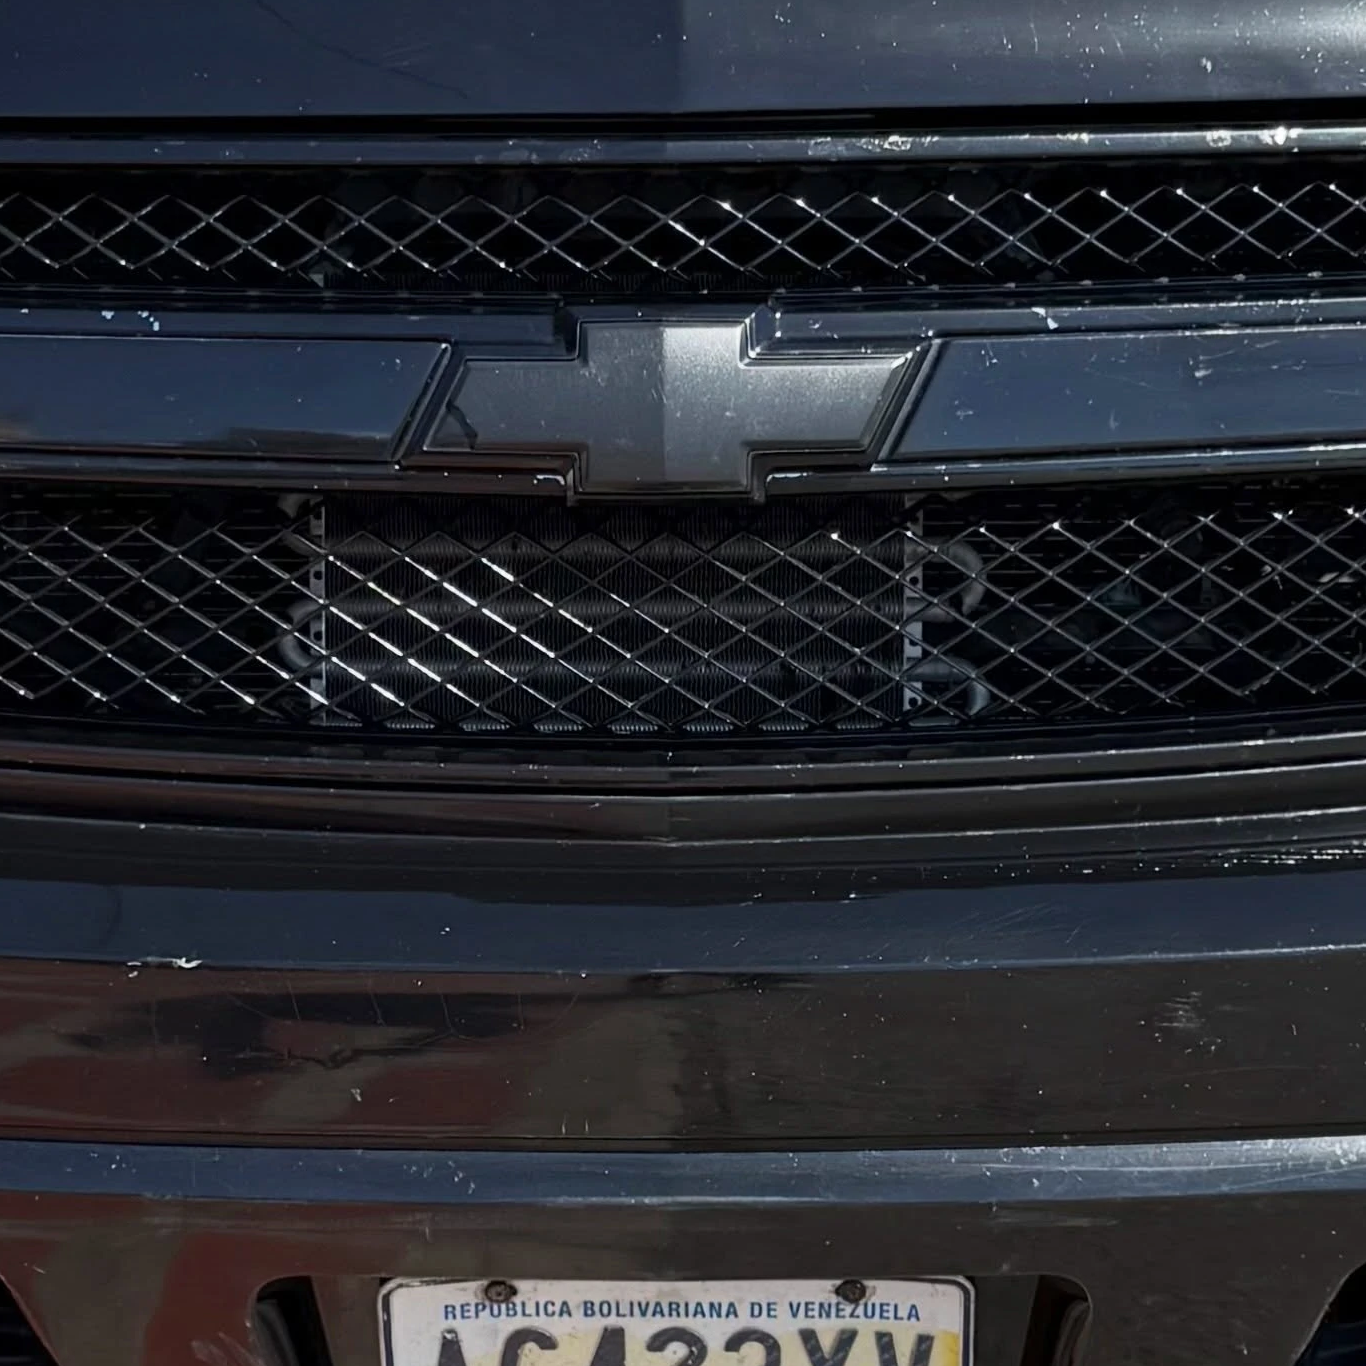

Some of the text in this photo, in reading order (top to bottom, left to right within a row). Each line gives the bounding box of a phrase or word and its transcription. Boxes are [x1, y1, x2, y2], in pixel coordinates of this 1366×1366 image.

[582, 1299, 739, 1320] BOLIVARIANA
[749, 1301, 778, 1319] DE
[788, 1301, 921, 1322] VENEZUELA
